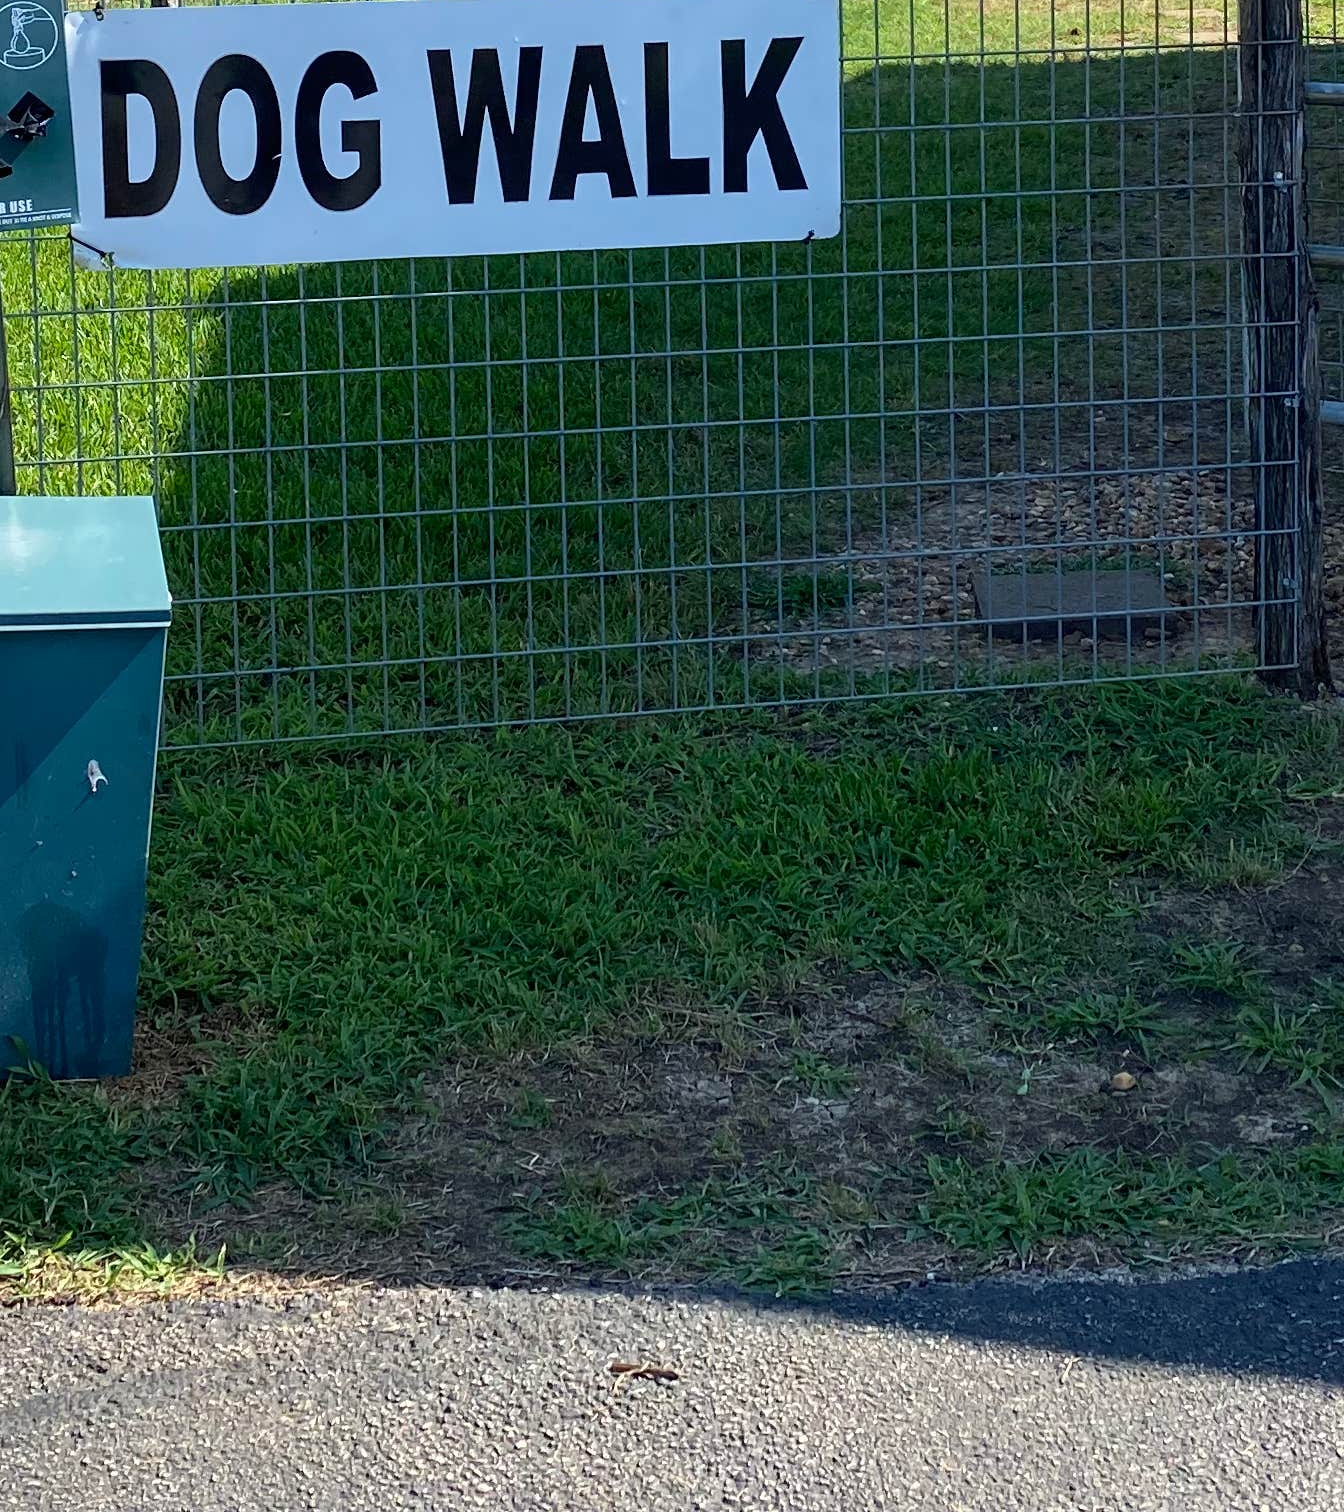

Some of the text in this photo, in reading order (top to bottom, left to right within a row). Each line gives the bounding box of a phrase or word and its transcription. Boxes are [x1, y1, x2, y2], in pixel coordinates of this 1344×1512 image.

[99, 36, 809, 220] DOG WALK
[9, 199, 33, 213] USE
